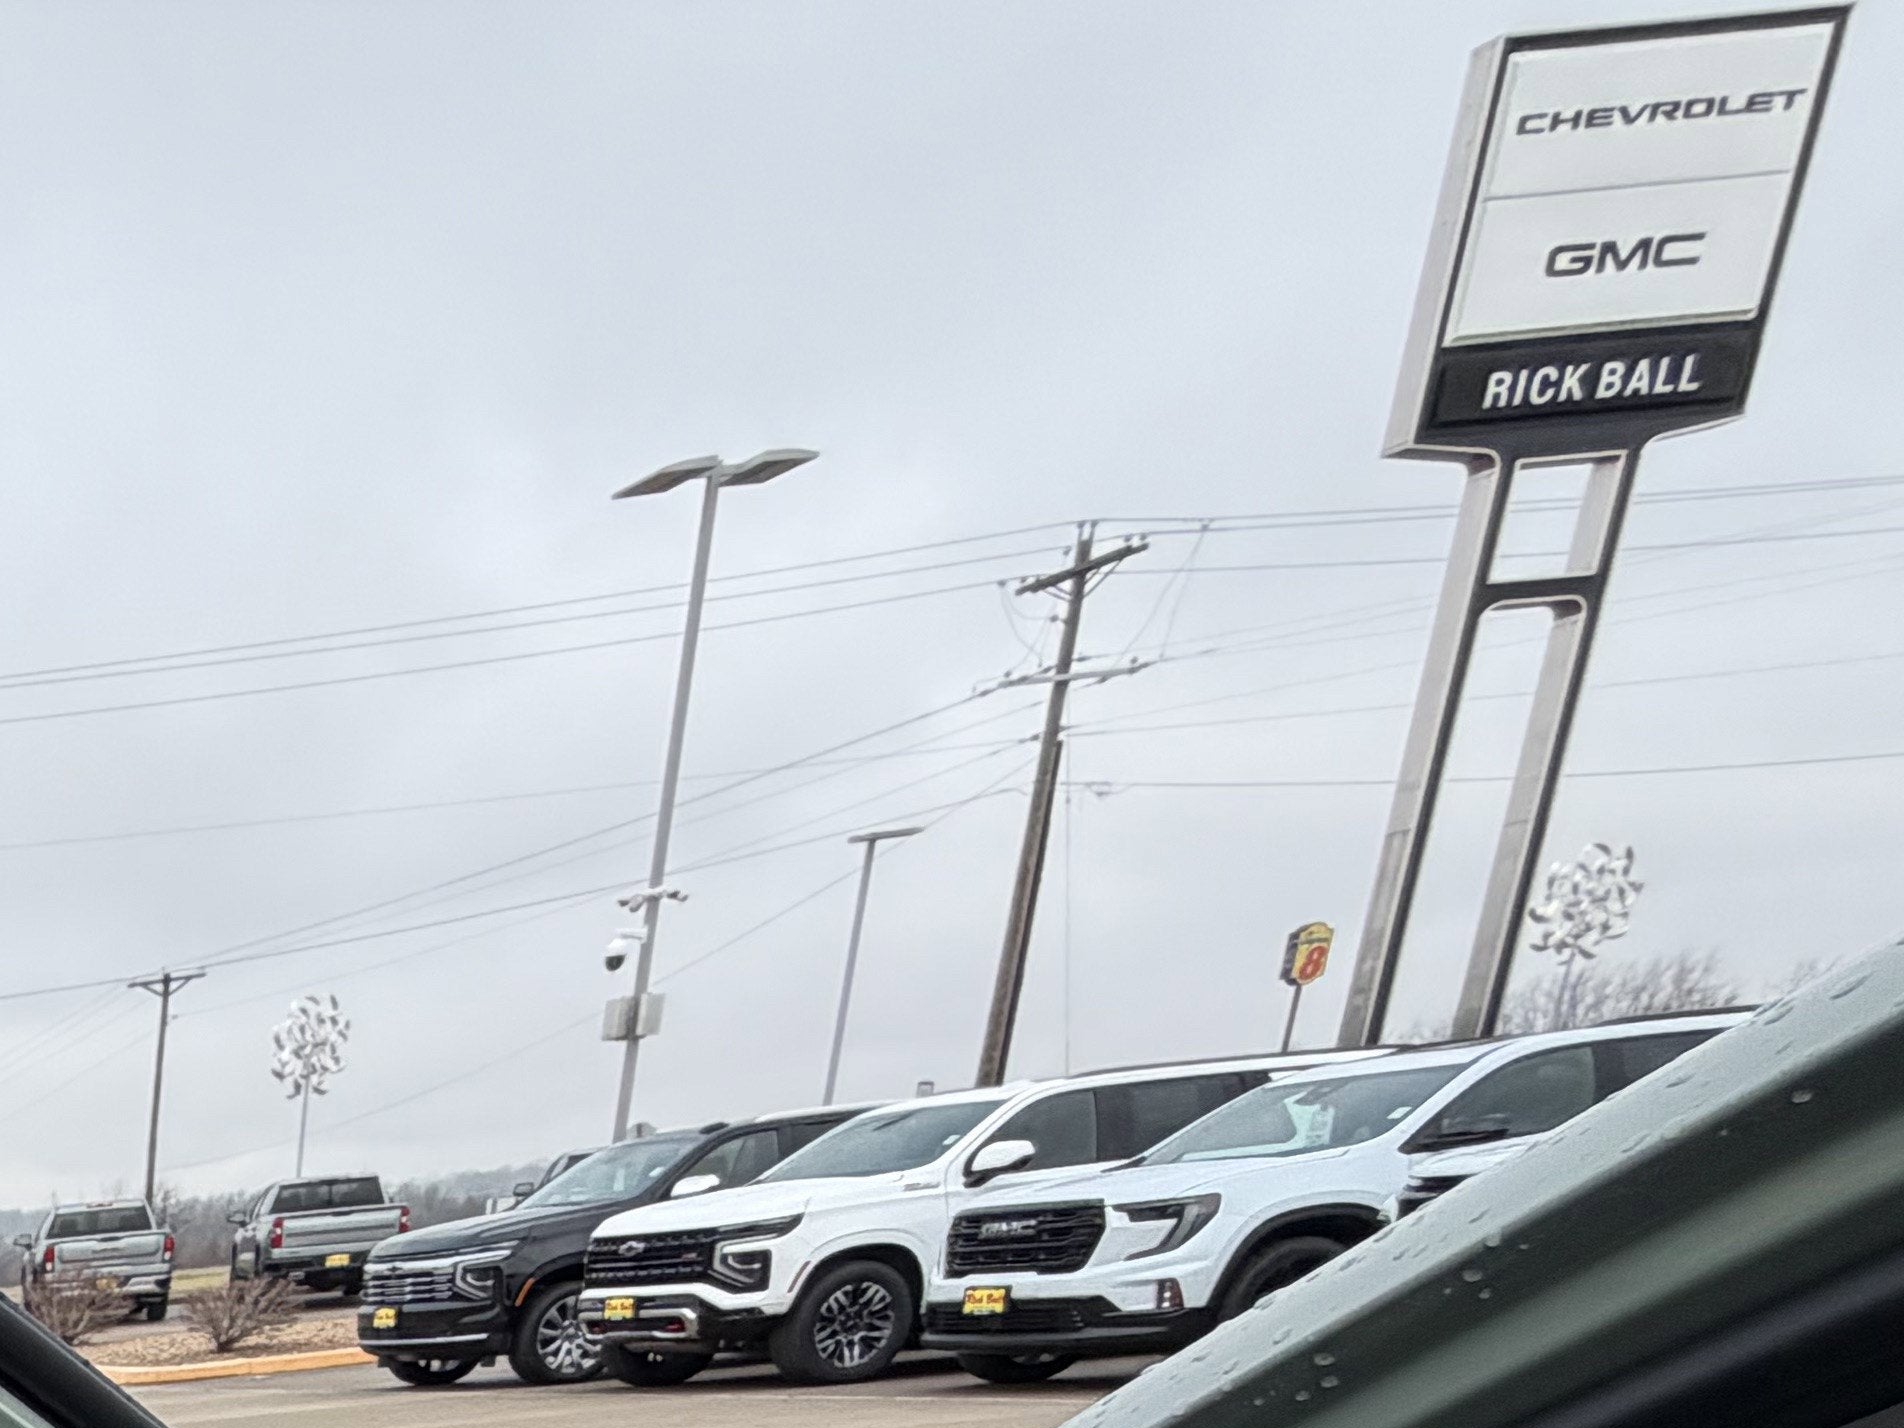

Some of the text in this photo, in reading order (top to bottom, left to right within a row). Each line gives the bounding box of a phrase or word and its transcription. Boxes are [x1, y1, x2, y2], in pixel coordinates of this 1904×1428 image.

[1515, 88, 1807, 136] CHEVROLET
[1545, 231, 1707, 278] GMC
[1482, 352, 1705, 410] RICK BALL
